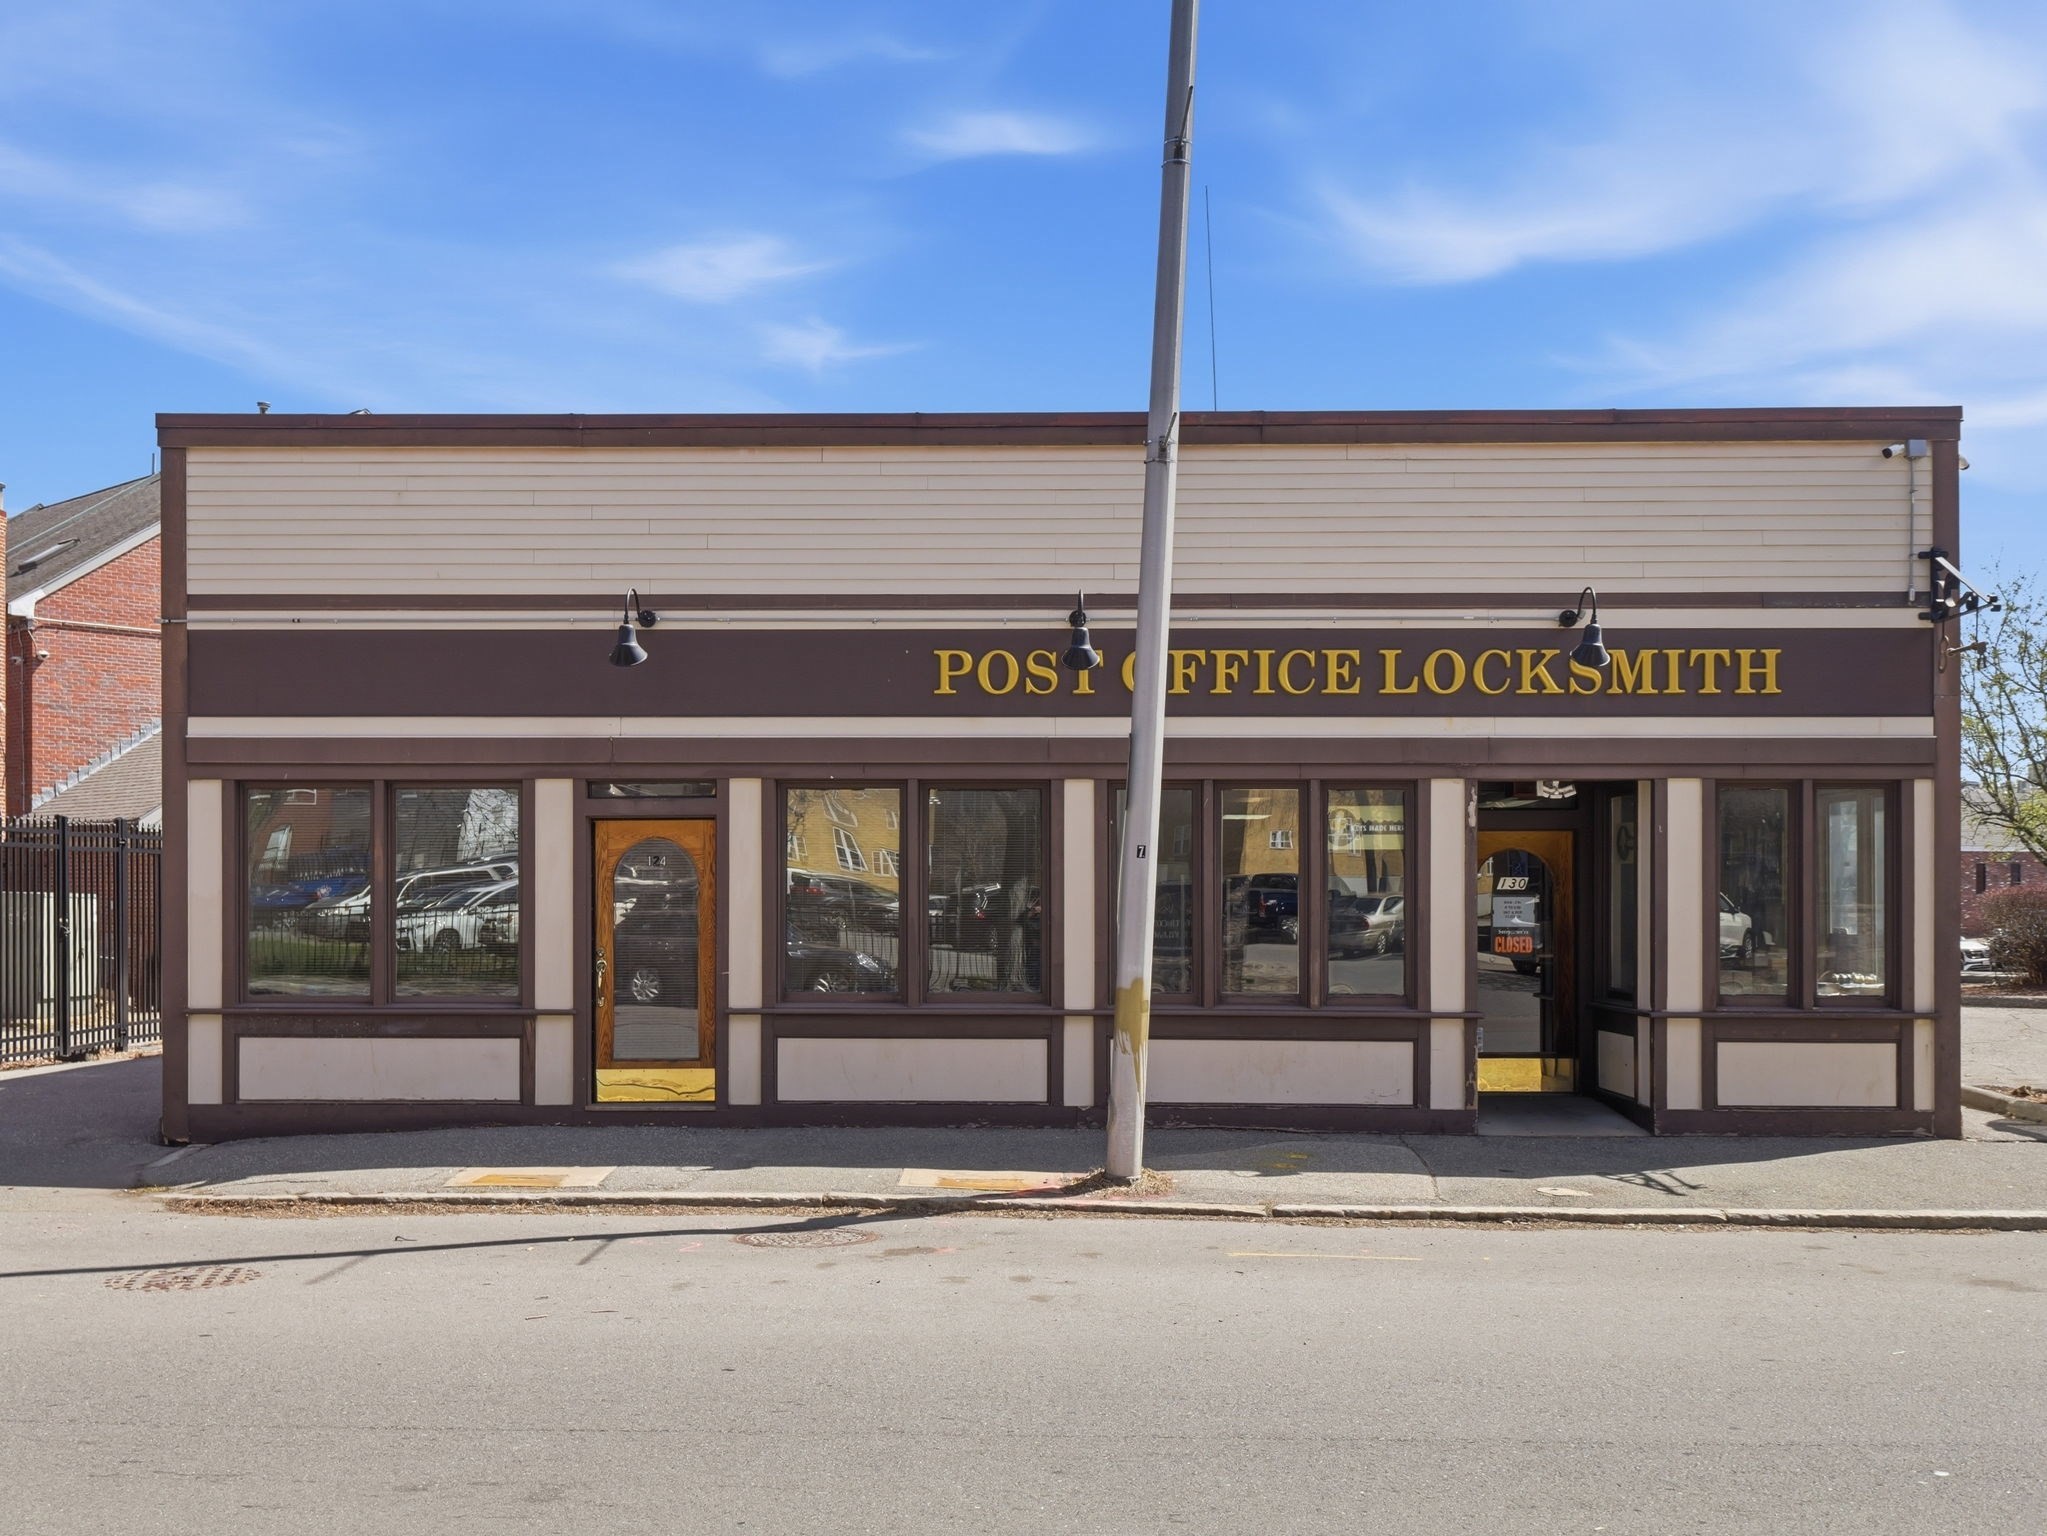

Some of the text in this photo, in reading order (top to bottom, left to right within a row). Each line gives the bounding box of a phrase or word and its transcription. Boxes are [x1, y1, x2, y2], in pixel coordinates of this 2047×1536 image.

[1378, 649, 1782, 694] LOCKSMITH
[648, 855, 666, 866] 124
[1500, 878, 1527, 889] 130
[1495, 936, 1533, 953] CLOSED
